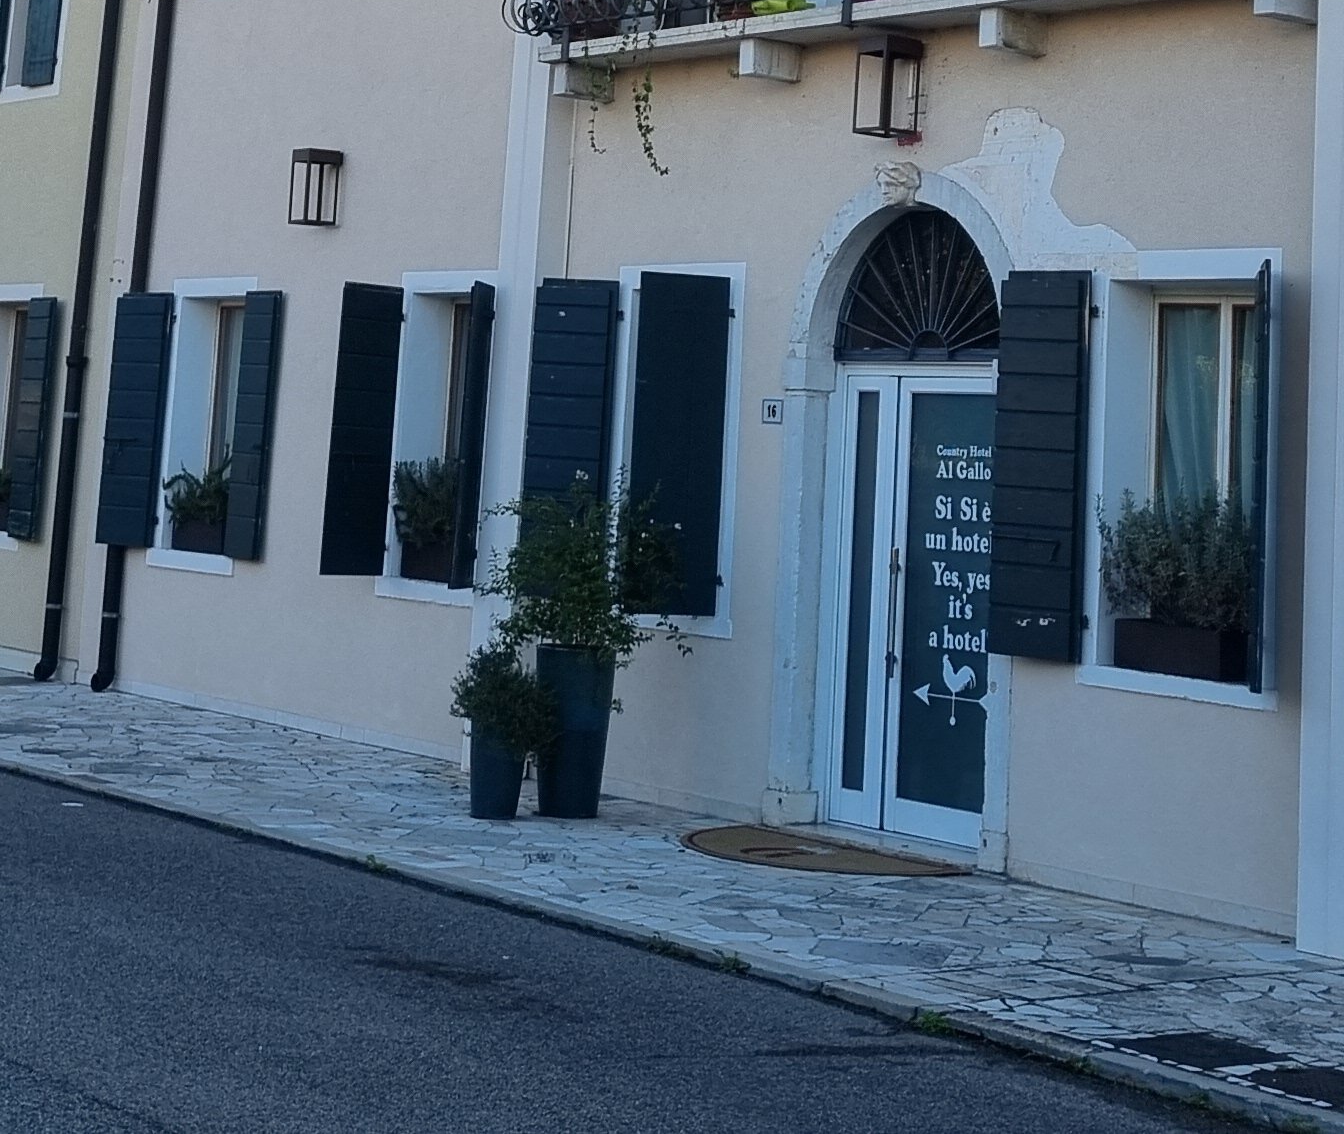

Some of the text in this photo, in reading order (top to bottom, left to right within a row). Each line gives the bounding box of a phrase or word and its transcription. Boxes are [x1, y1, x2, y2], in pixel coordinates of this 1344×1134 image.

[767, 405, 777, 418] 16
[937, 444, 992, 459] Country Hotel
[936, 460, 992, 480] Al Gallo
[935, 495, 991, 522] Si Si è
[925, 533, 946, 550] un
[931, 561, 991, 594] Yes, yes
[948, 593, 973, 620] it's
[928, 631, 938, 647] a
